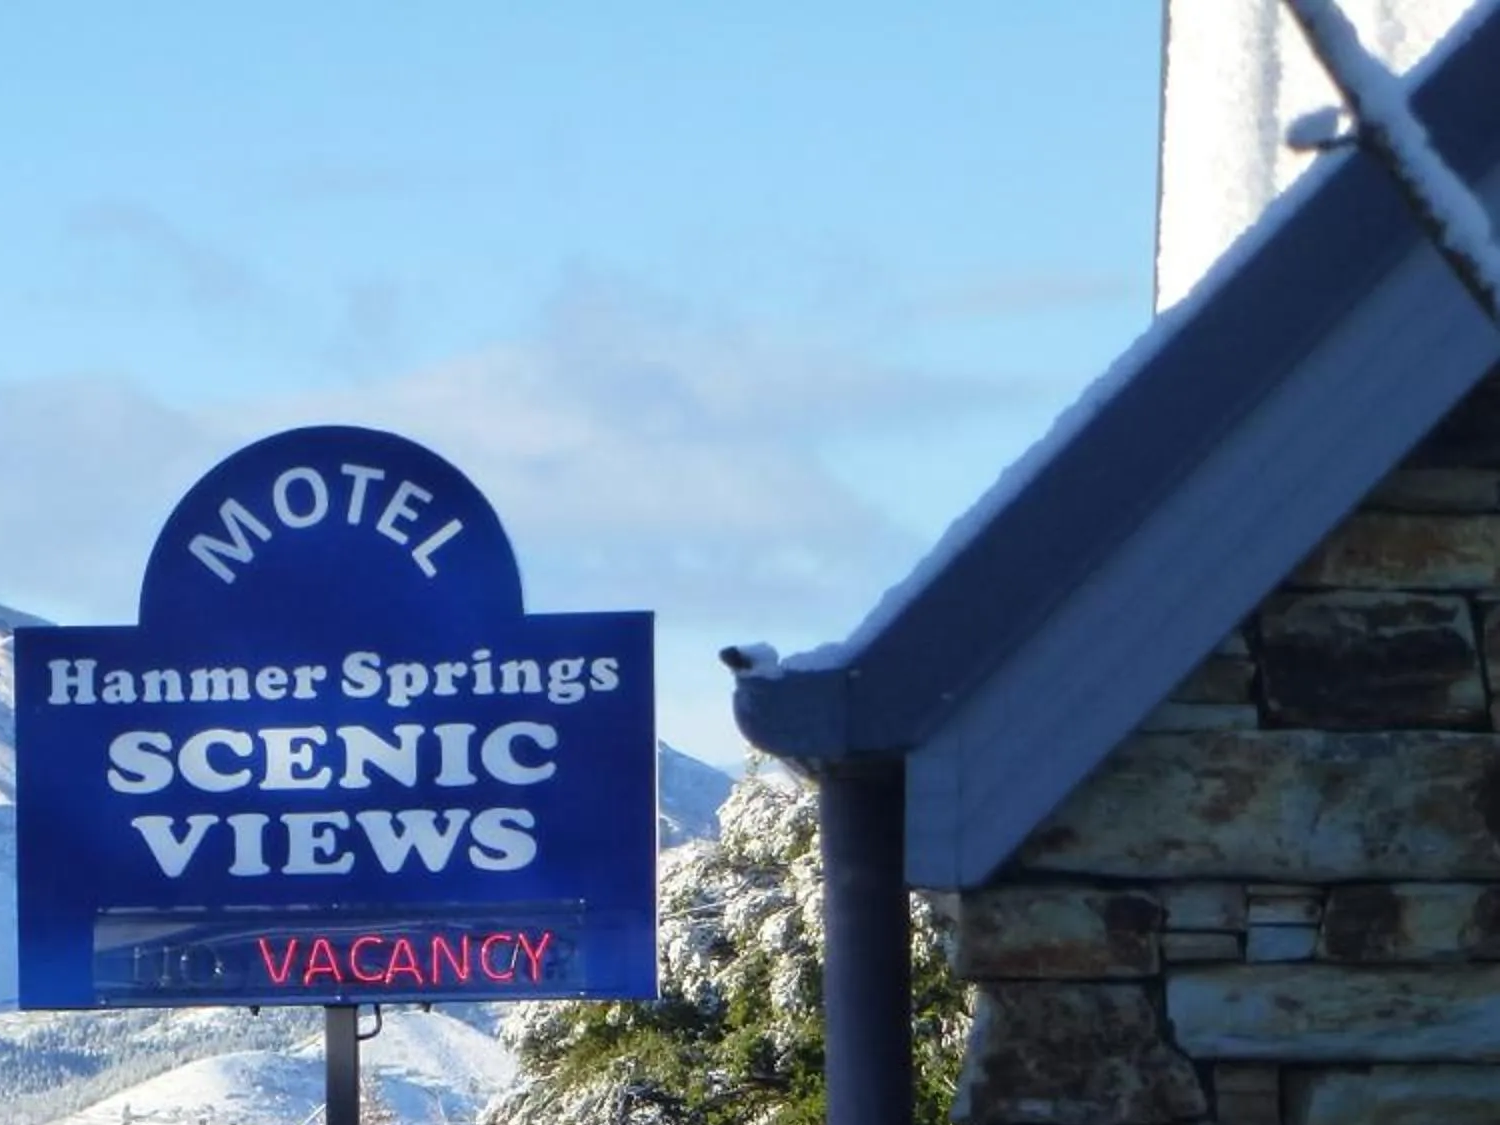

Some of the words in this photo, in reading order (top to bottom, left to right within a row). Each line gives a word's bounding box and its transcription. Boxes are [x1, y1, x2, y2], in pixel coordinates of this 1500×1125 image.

[188, 463, 464, 584] MOTEL
[47, 657, 326, 706] Hanmer
[341, 649, 620, 707] Springs
[106, 721, 559, 794] SCENIC
[131, 808, 538, 878] VIEWS
[258, 931, 551, 986] VACANCY
